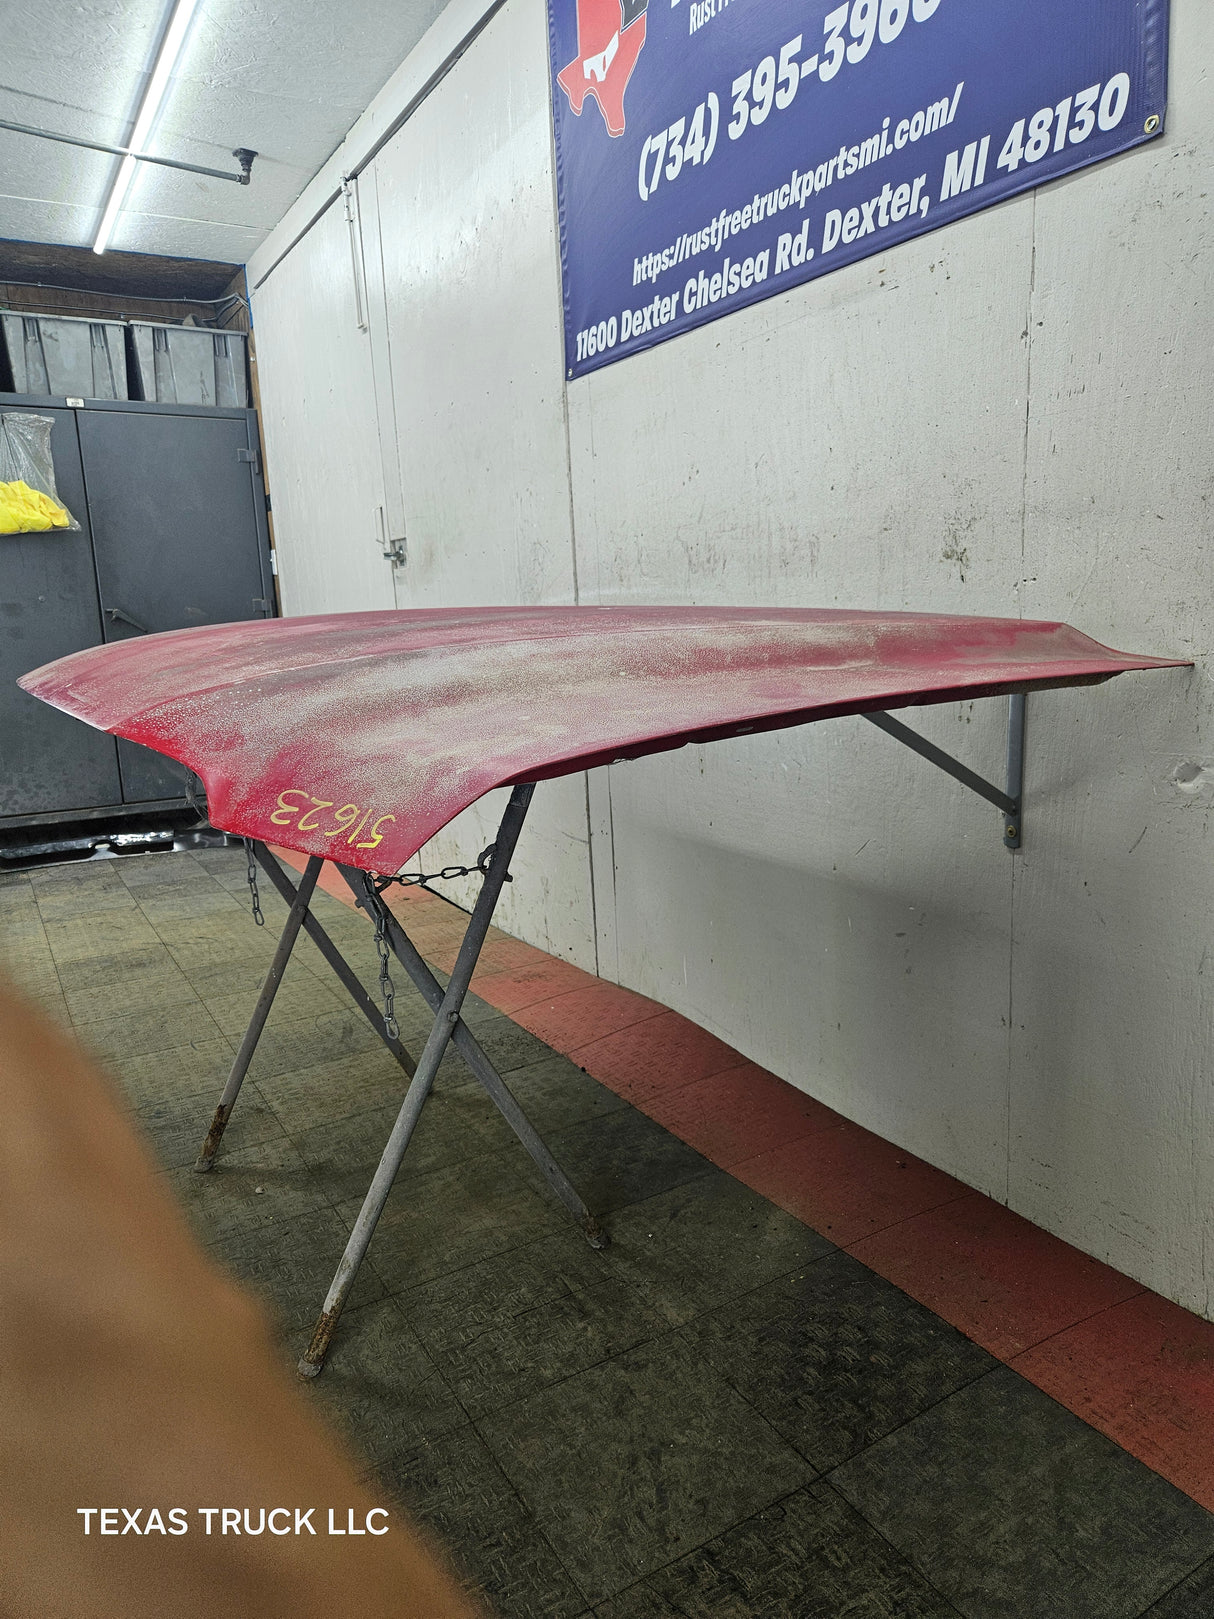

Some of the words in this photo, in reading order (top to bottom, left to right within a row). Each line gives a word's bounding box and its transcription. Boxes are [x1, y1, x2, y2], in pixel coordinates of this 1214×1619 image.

[576, 316, 618, 361] 11600
[620, 291, 680, 343] Dexter
[683, 249, 770, 314] Chelsea
[774, 218, 814, 274] Rd.
[821, 173, 930, 254] Dexter,
[940, 135, 991, 202] MI
[996, 72, 1130, 173] 48130
[632, 81, 965, 286] https://rustfreetruckpartsmi.com/
[638, 92, 719, 201] (734)
[270, 789, 396, 849] 51623
